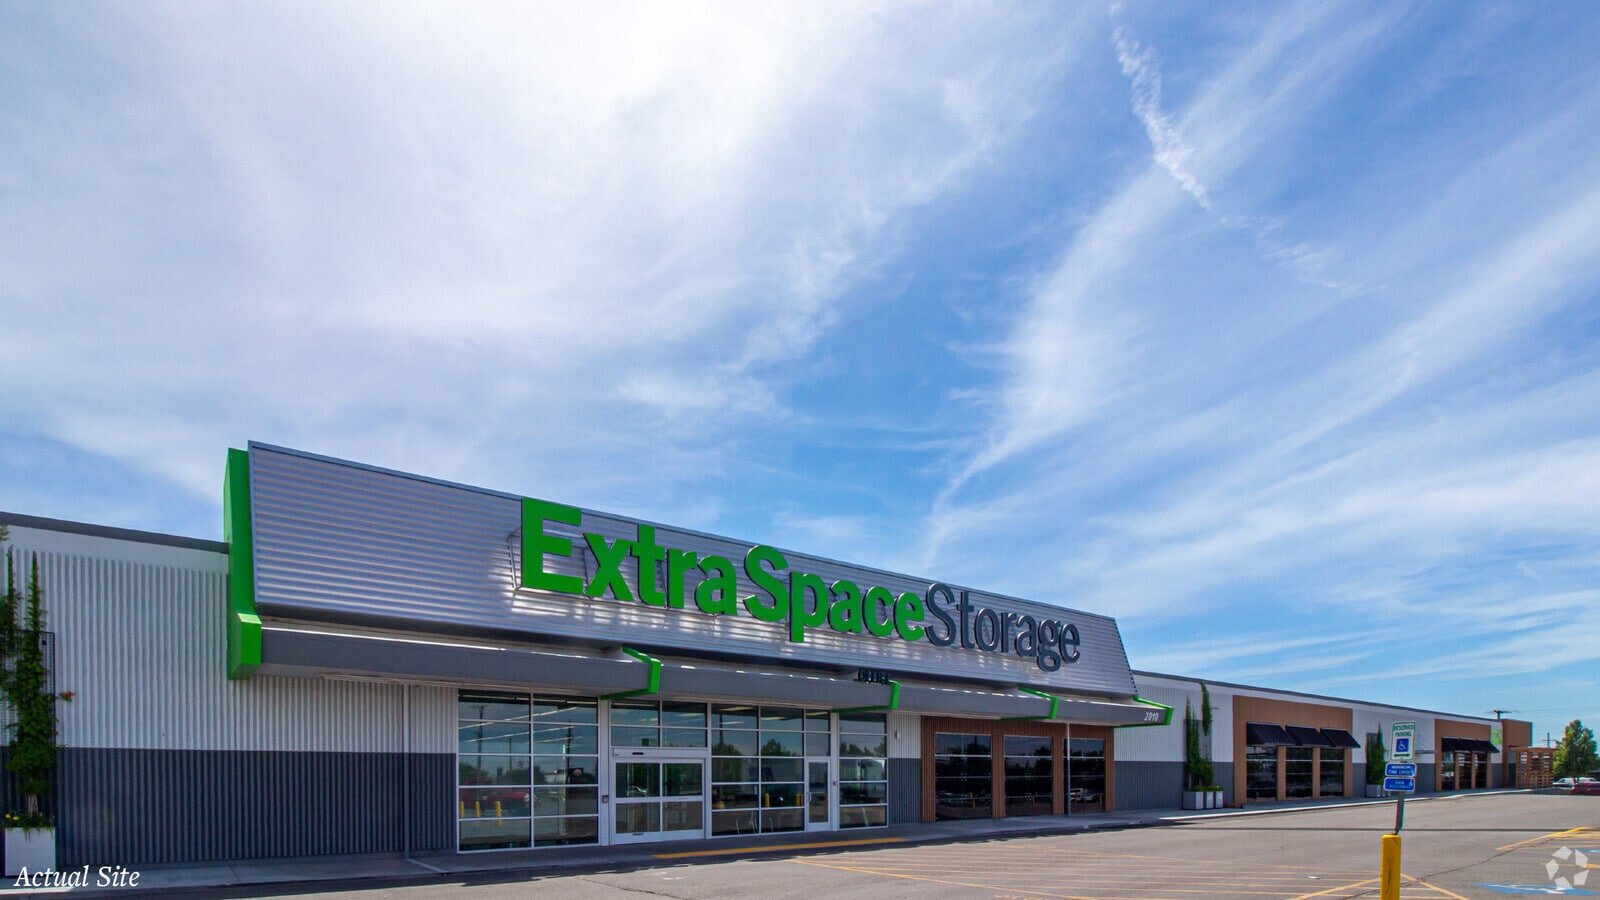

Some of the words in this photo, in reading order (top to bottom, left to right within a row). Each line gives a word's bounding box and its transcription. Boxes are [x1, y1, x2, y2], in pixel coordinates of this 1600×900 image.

[521, 498, 738, 616] Extra
[743, 545, 925, 643] Space
[925, 582, 1081, 671] Storage
[1143, 711, 1160, 722] 2010
